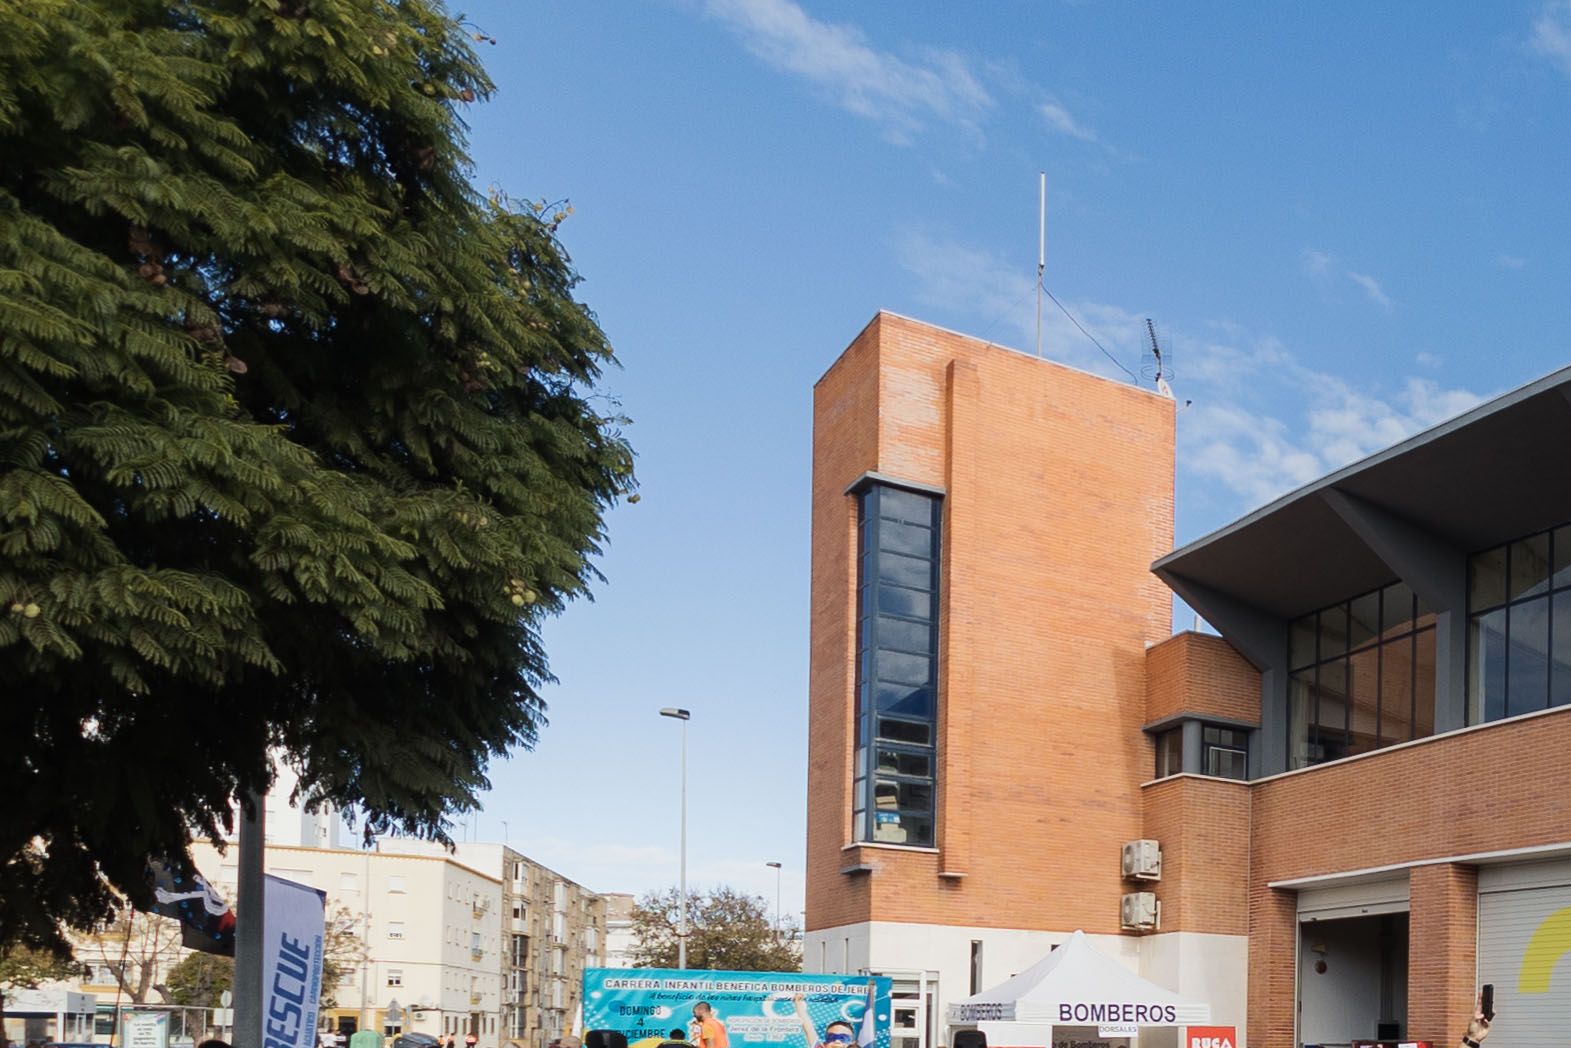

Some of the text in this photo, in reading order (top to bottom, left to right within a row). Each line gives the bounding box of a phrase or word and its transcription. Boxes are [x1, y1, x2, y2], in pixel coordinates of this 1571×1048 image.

[605, 979, 868, 994] CARRERA INFANTIL BENEFICA BOMBEROS DE JERE
[619, 1005, 662, 1016] DOMINGO
[1059, 1003, 1176, 1023] BOMBEROS
[636, 1018, 645, 1027] 4
[617, 1028, 666, 1039] ICIEMBRE
[1099, 1025, 1137, 1033] DORSALES
